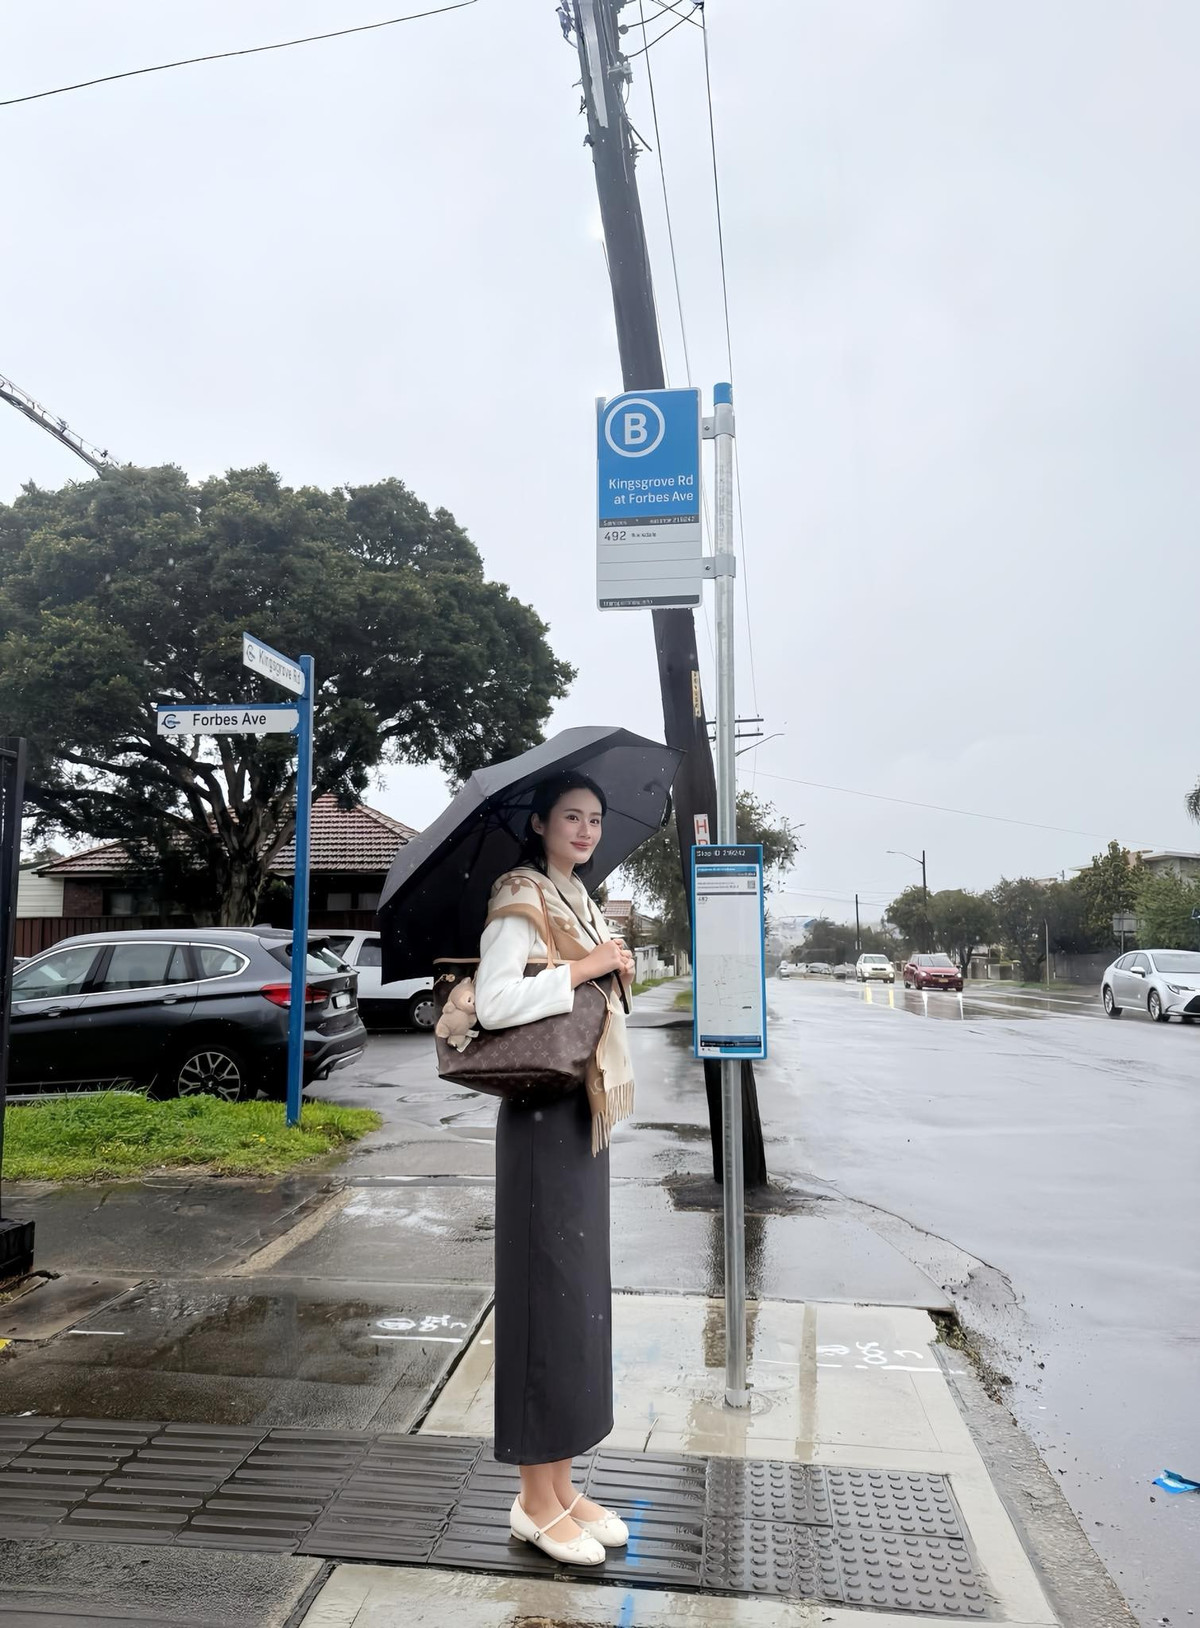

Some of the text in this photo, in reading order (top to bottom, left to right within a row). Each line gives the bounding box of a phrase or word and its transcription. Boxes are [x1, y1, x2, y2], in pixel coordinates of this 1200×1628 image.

[625, 413, 648, 445] B
[609, 475, 694, 490] Kingsgrove Rd
[614, 491, 694, 505] at Forbes Ave
[604, 531, 627, 541] 492
[193, 712, 267, 726] Forbes Ave
